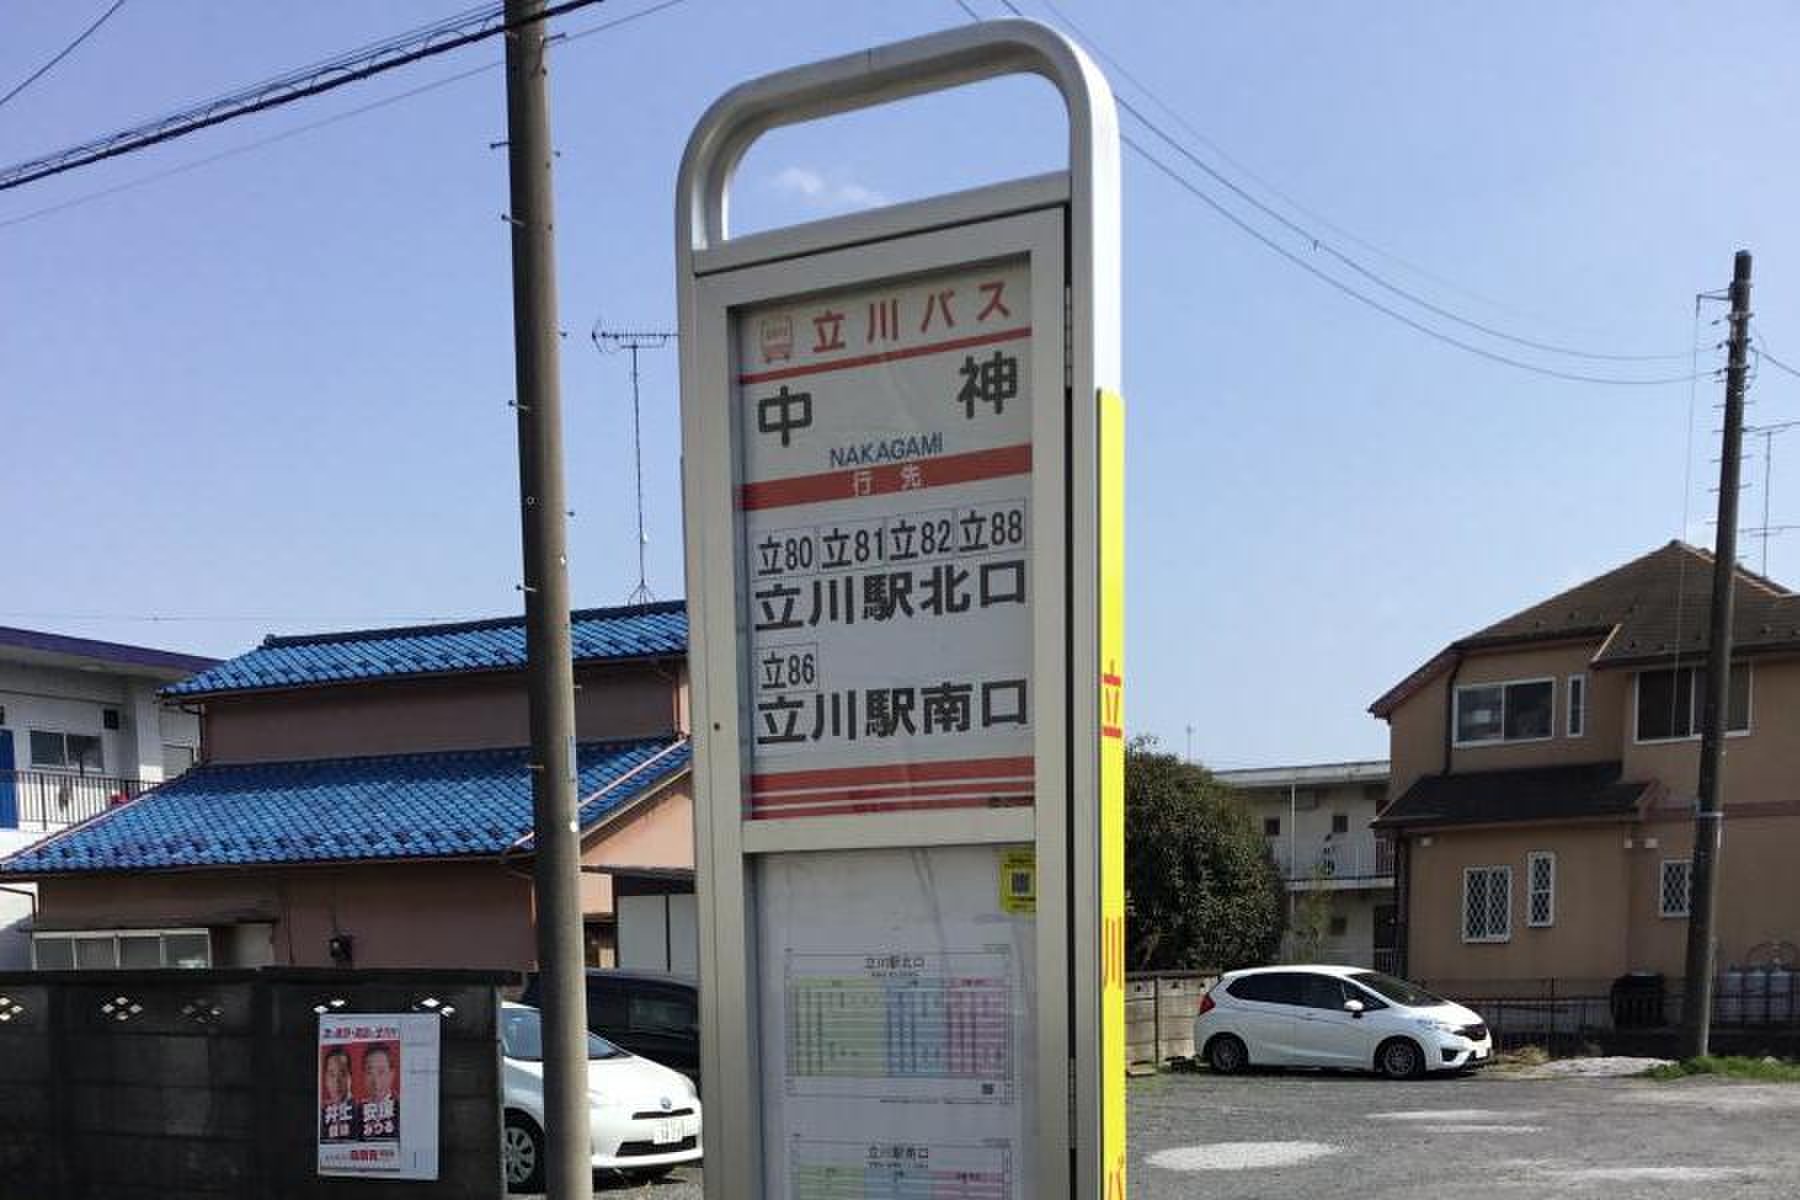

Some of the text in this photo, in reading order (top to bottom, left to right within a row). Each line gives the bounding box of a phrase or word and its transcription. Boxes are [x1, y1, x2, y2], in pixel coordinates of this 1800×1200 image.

[812, 280, 1011, 353] 立川バス
[757, 350, 1018, 448] 中神
[829, 432, 945, 468] NAKAGAMI
[851, 463, 926, 497] 行先
[757, 509, 1024, 577] 立80 立81 立82 立88
[755, 558, 1027, 632] 立川駅北口
[760, 648, 816, 690] 立86
[757, 677, 1029, 745] 立川駅南口
